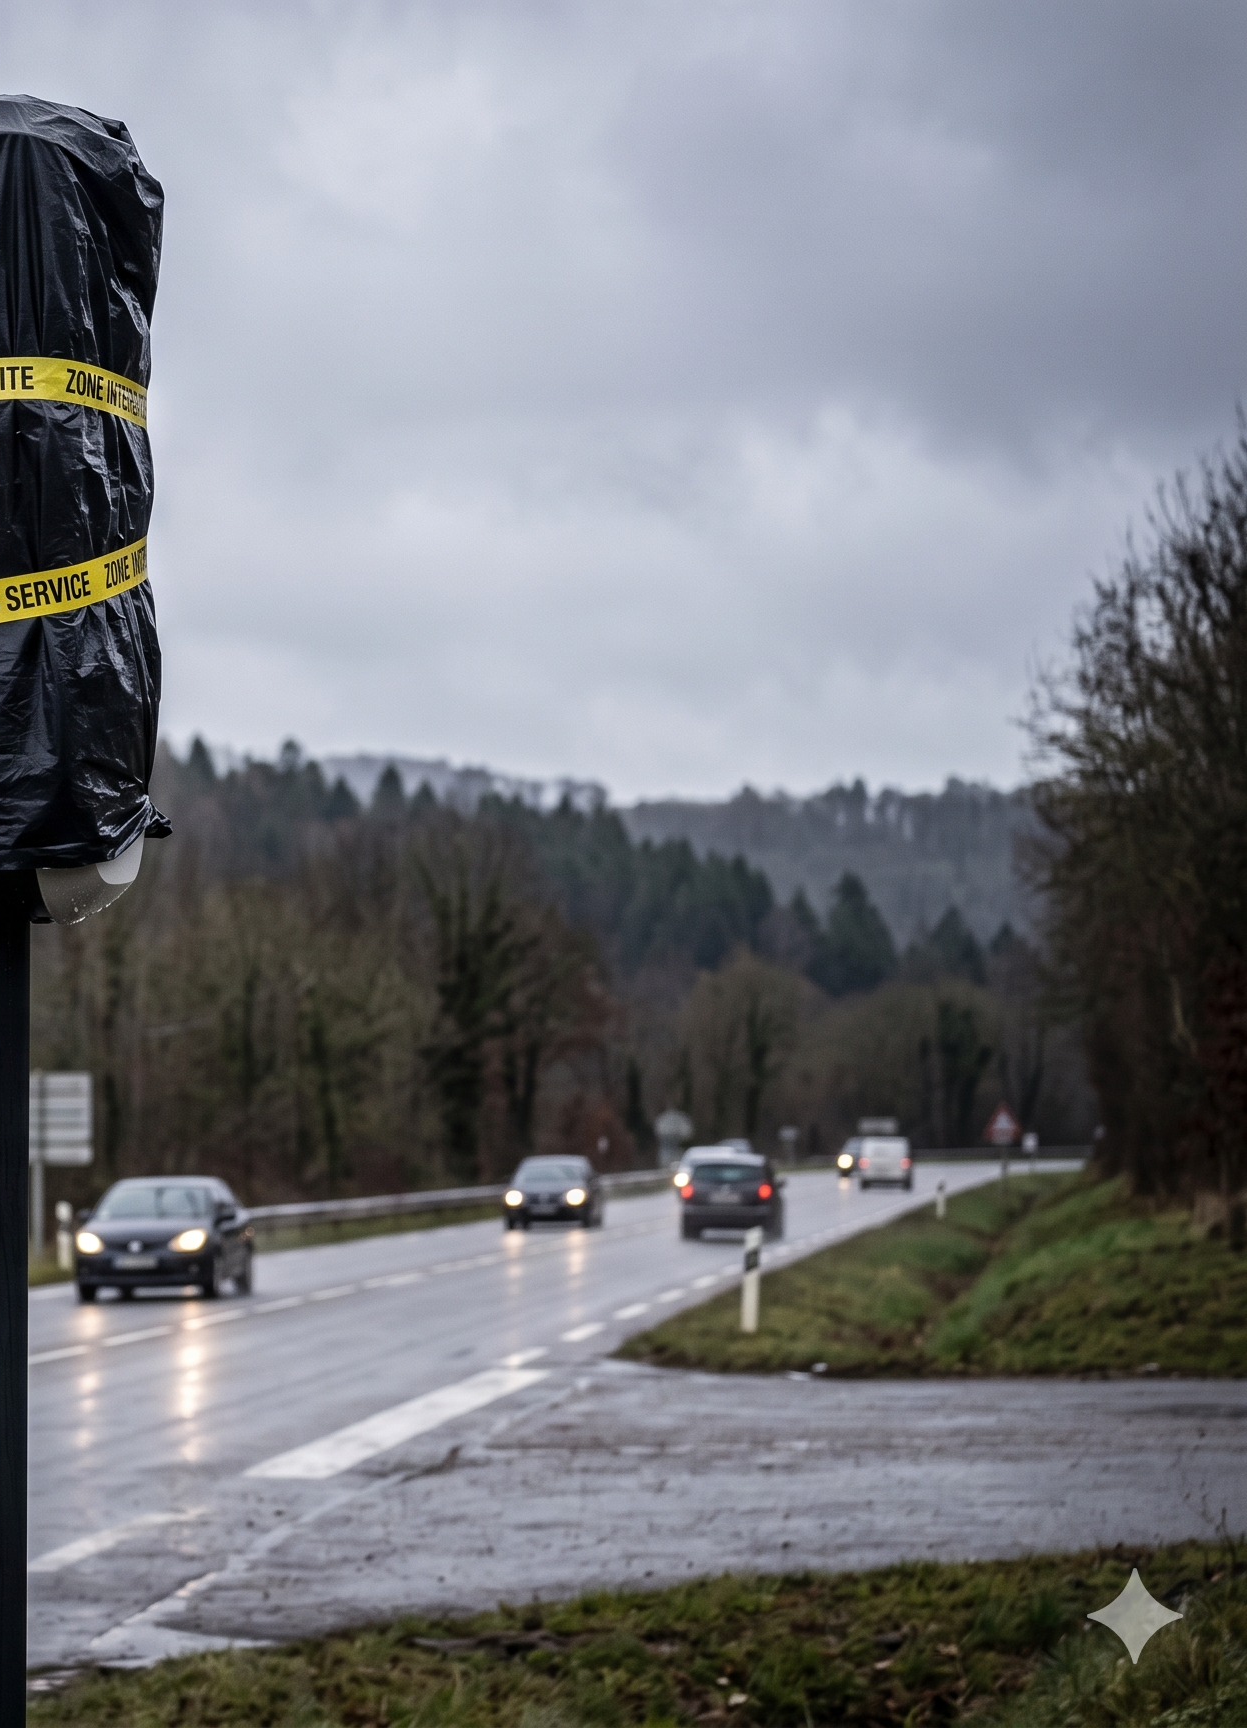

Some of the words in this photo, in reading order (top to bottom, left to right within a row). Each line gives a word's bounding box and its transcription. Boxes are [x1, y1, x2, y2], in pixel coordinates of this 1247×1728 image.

[65, 368, 104, 401] ZONE
[104, 555, 130, 589] ZONE
[6, 570, 91, 611] SERVICE
